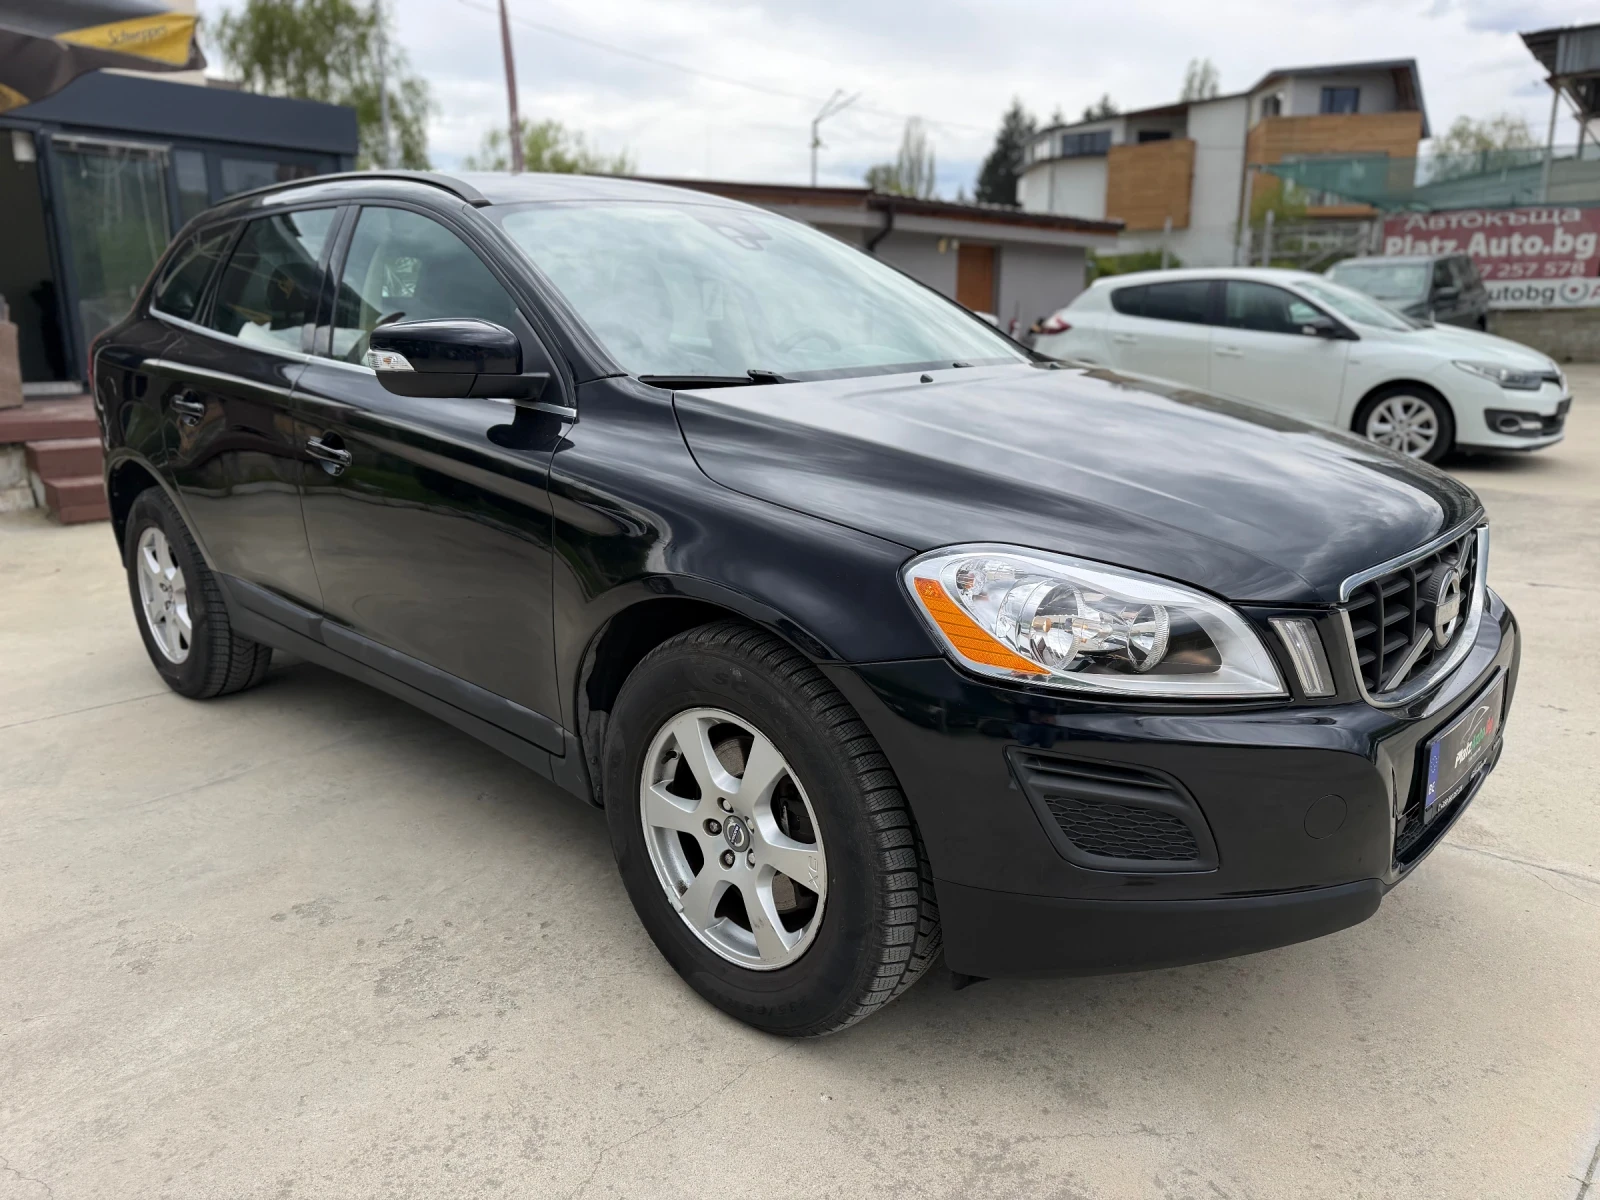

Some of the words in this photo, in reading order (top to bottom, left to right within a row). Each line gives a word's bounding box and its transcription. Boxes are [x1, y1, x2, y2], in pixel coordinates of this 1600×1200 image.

[1480, 263, 1493, 278] 7
[1497, 262, 1538, 278] 257
[1544, 260, 1585, 276] 578
[1488, 285, 1555, 304] utobg
